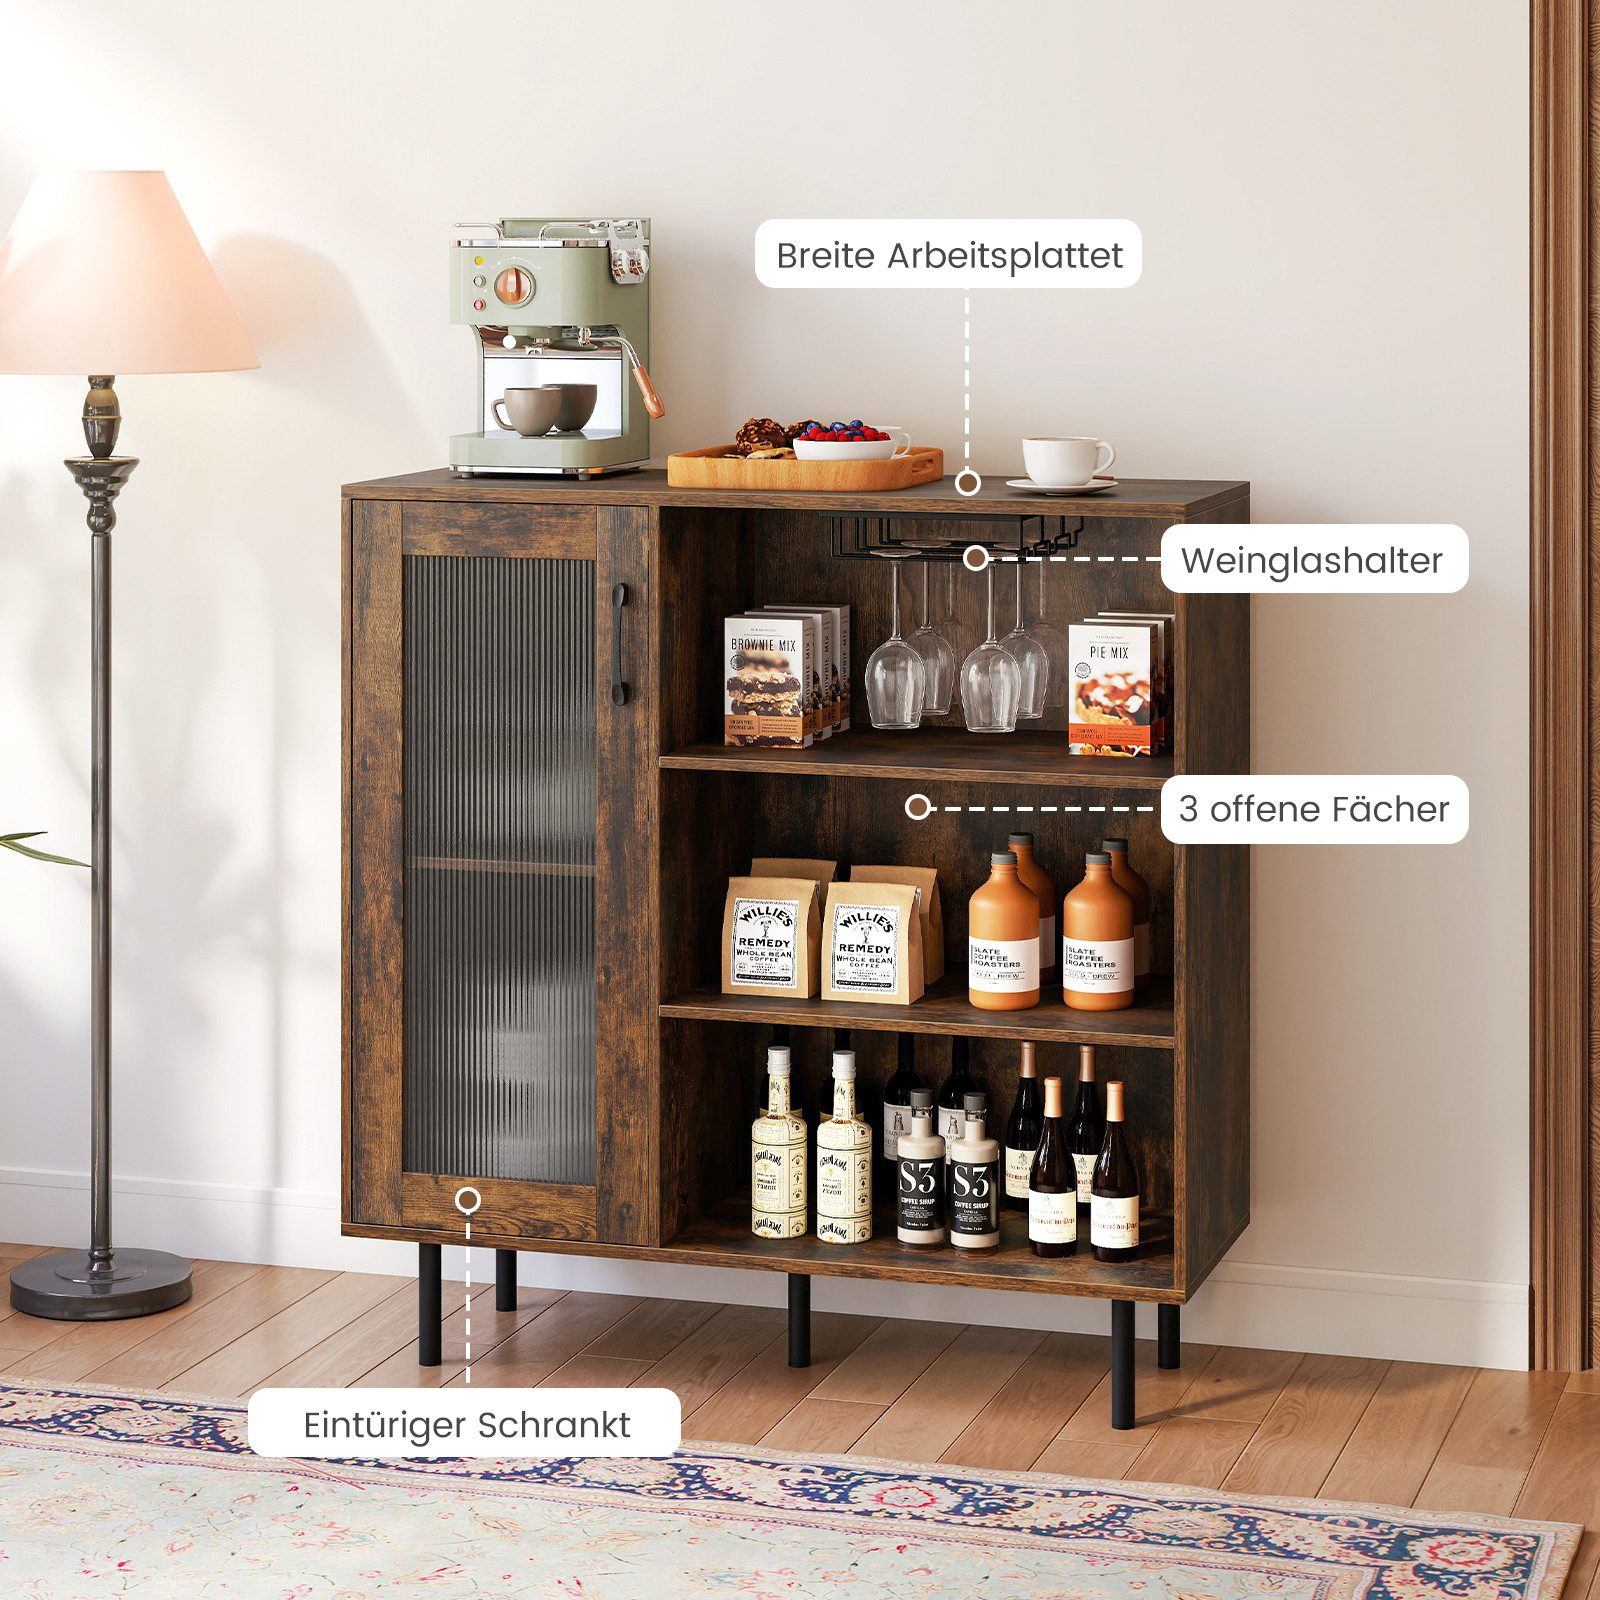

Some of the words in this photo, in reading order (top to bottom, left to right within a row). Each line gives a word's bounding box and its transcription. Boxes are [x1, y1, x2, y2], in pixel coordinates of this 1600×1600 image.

[731, 638, 774, 651] BROWNIE
[779, 640, 796, 652] MIX
[1090, 646, 1106, 658] PIE
[1111, 647, 1129, 660] MIX
[739, 906, 793, 927] WILLIE'S
[839, 912, 894, 933] WILLIE'S
[739, 938, 790, 948] REMEDY
[736, 949, 766, 957] WHOLE
[768, 951, 792, 959] BEAN
[839, 944, 891, 954] REMEDY
[974, 946, 1001, 955] SLATE
[1068, 946, 1096, 955] SLATE
[836, 955, 866, 963] WHOLE
[869, 957, 893, 965] BEAN
[974, 953, 1008, 962] COFFEE
[1068, 953, 1104, 962] COFFEE
[974, 959, 1021, 968] ROASTERS
[1068, 959, 1116, 968] ROASTERS
[899, 1161, 936, 1194] S3
[953, 1165, 989, 1198] S3
[954, 1200, 972, 1209] COFFEE
